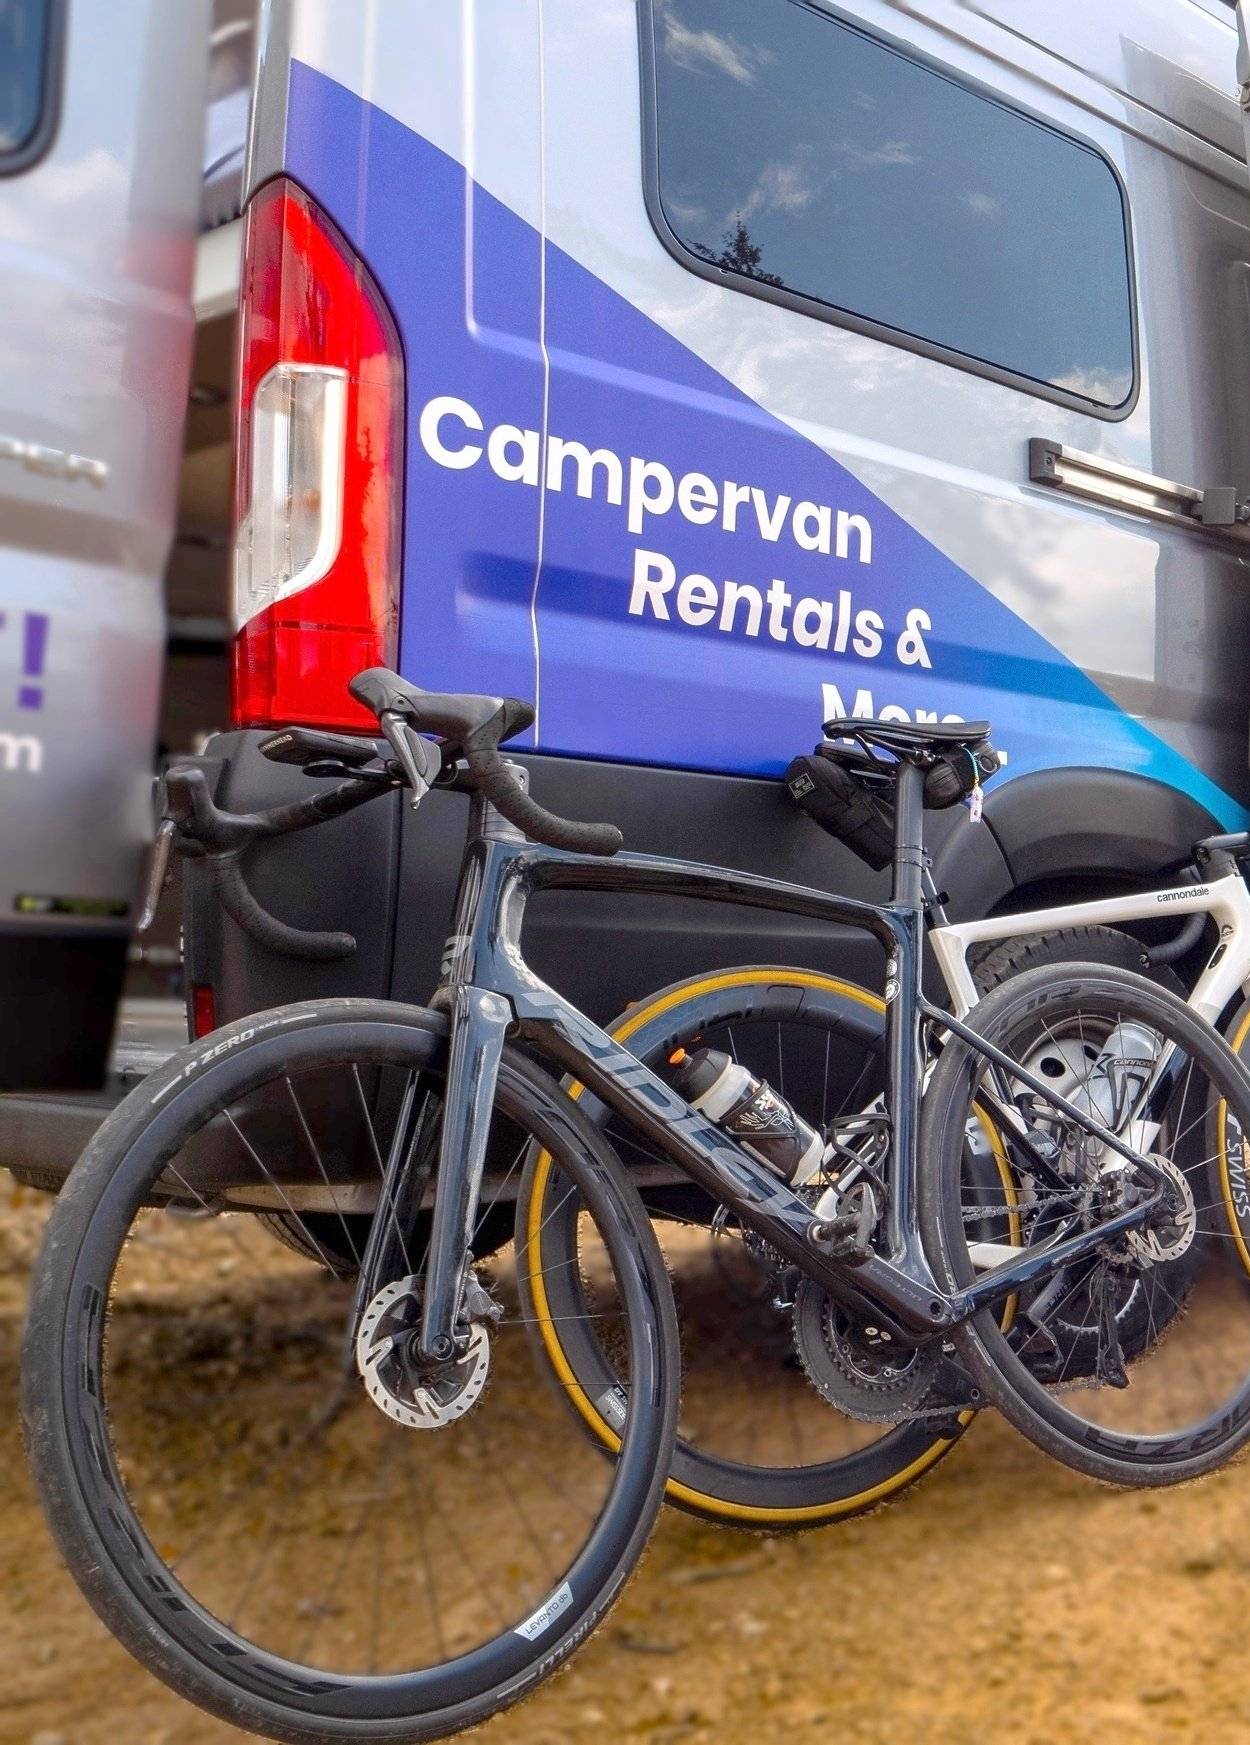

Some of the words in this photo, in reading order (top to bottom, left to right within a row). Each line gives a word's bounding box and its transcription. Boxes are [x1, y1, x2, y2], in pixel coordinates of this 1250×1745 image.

[418, 396, 873, 563] Campervan
[628, 548, 884, 659] Rentals
[895, 607, 933, 668] &
[1157, 887, 1210, 902] cannondale
[200, 1028, 255, 1065] ZERO
[521, 992, 812, 1227] RIDLEY
[525, 1601, 560, 1635] LEVANTO
[538, 1610, 598, 1675] PIRELLI
